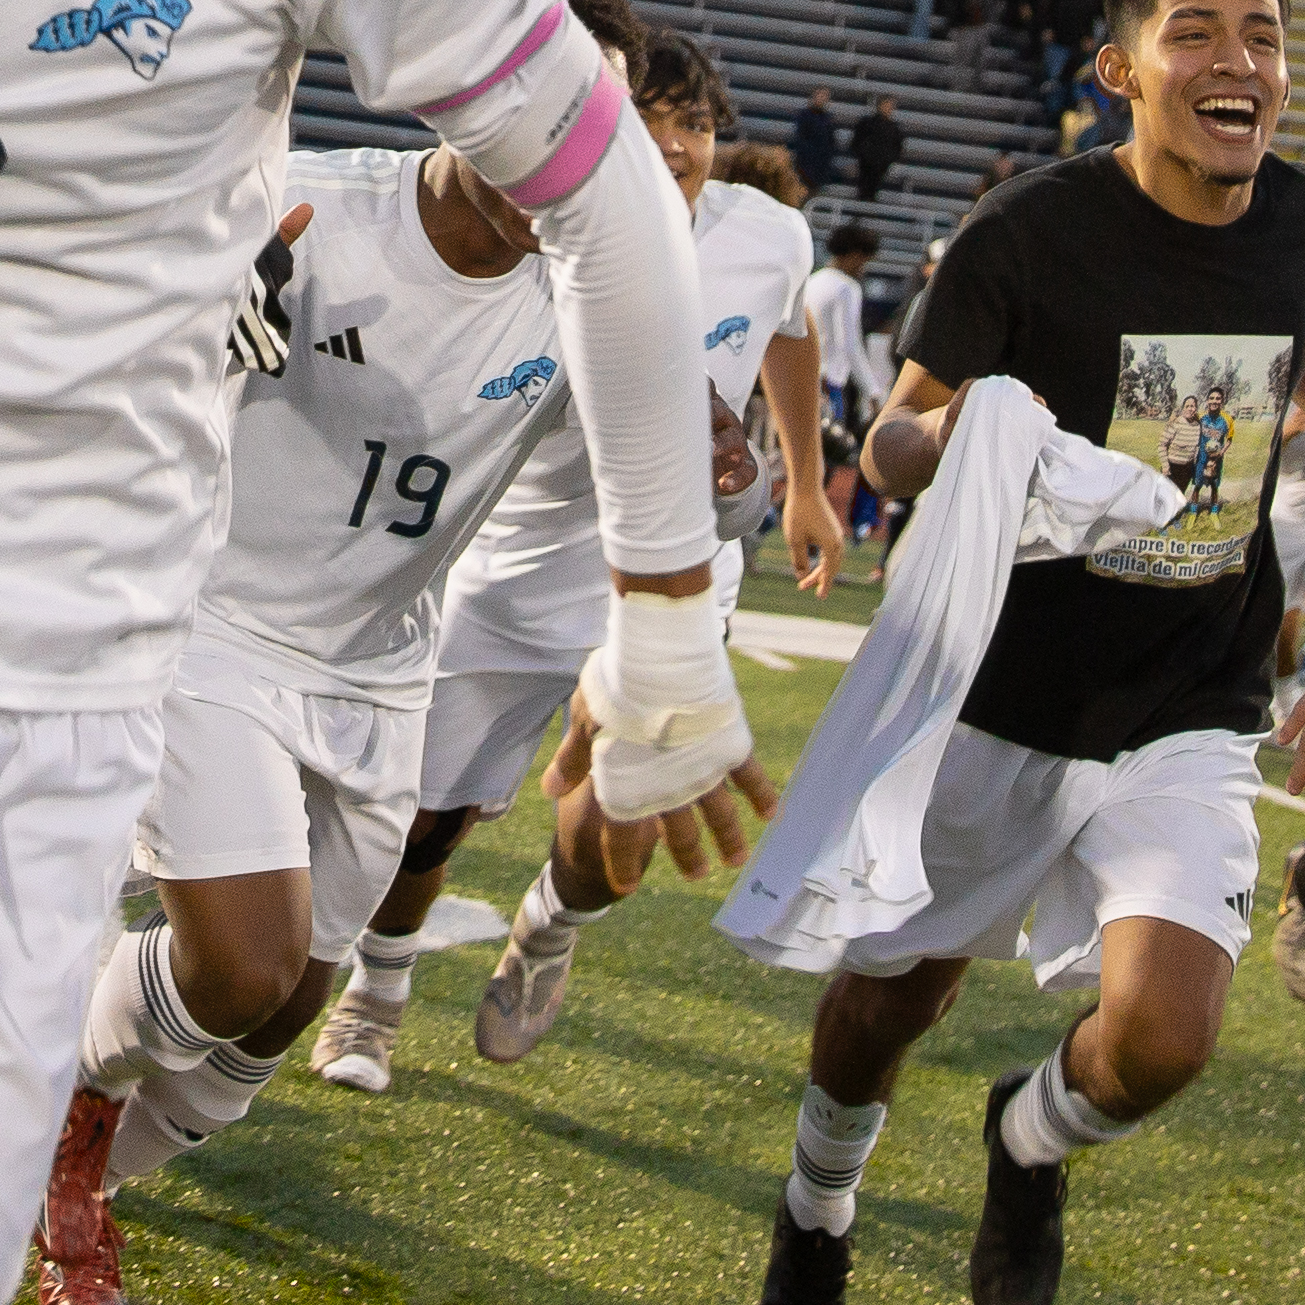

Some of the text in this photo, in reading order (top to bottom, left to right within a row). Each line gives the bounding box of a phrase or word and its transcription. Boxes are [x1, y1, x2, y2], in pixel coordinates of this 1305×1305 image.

[347, 440, 452, 539] 19
[1170, 540, 1185, 554] te
[1152, 560, 1172, 576] de
[1177, 562, 1198, 577] mi
